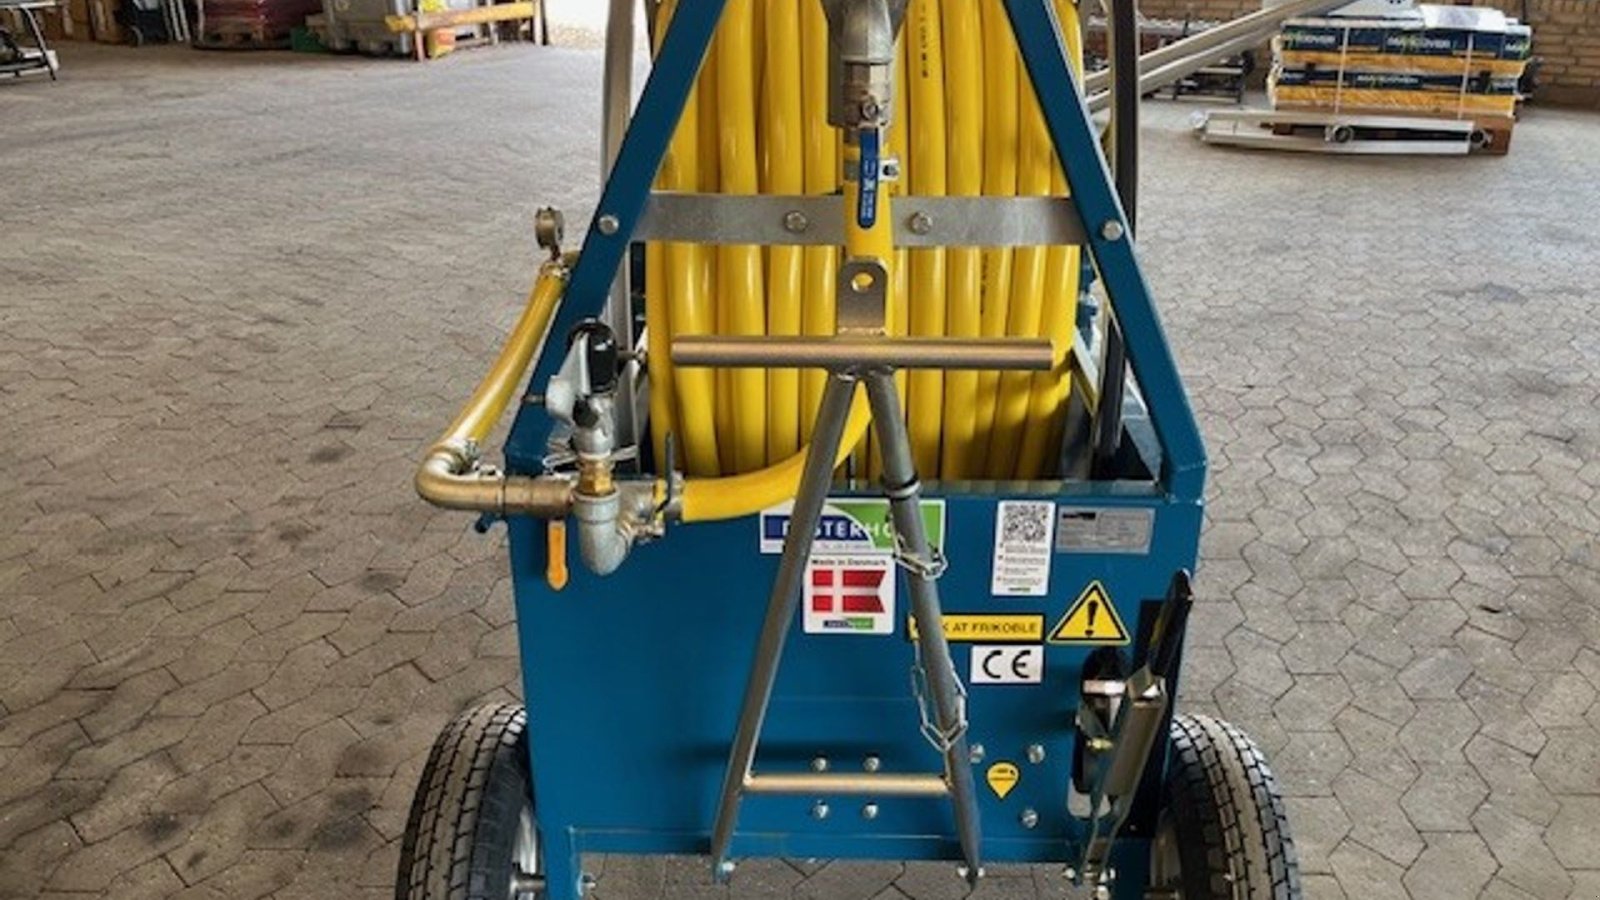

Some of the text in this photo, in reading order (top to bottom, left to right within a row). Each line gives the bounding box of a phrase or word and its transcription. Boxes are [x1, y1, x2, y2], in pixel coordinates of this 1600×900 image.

[811, 557, 887, 566] Made in Denmark
[953, 622, 968, 632] AT
[972, 622, 1038, 634] FRIKOBLE
[982, 649, 1031, 679] CE
